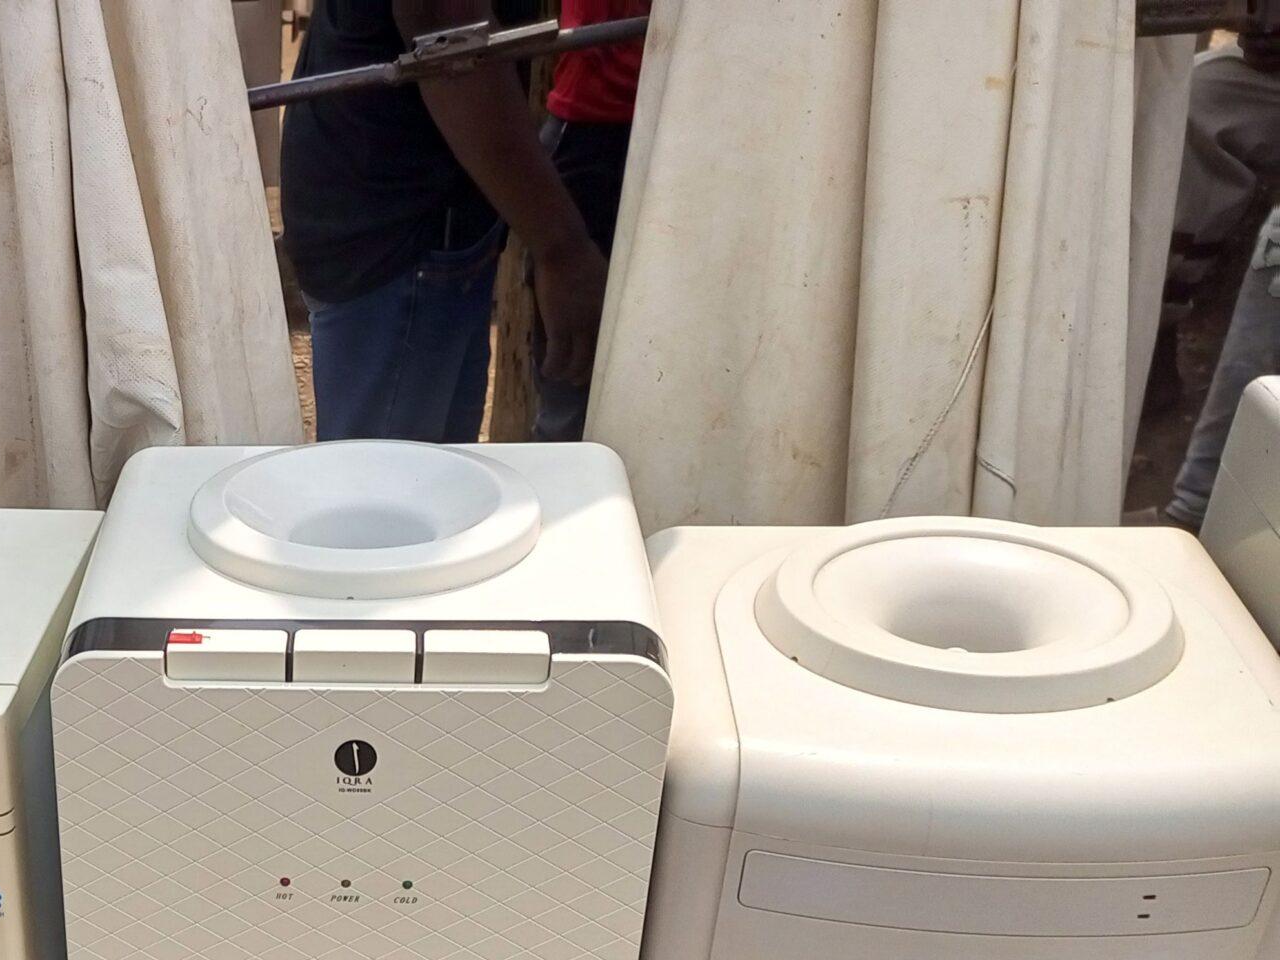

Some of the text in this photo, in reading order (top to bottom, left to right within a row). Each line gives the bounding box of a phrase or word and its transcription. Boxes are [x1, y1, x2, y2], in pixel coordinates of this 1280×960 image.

[275, 892, 294, 901] HOT
[330, 894, 360, 903] POWER
[393, 896, 418, 904] COLD
